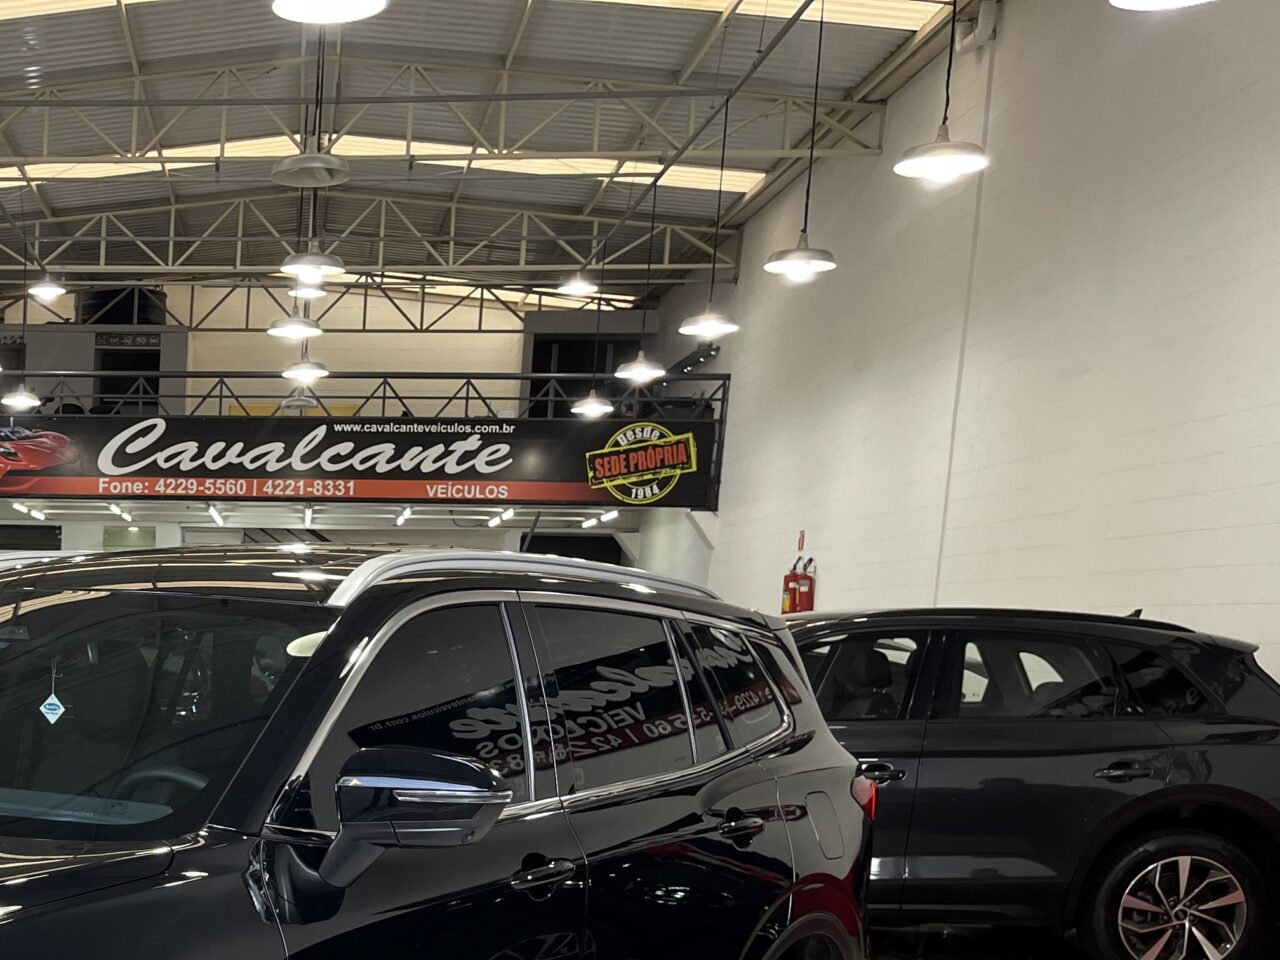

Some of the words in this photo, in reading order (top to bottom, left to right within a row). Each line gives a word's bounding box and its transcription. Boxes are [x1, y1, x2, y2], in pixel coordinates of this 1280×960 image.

[333, 422, 516, 434] www.cavalcanteveiculos.com.br
[97, 417, 513, 476] Cavalcante
[594, 454, 628, 478] SEDE
[628, 443, 688, 472] PRÓPRIA
[98, 477, 150, 494] Fone:
[155, 478, 247, 495] 4229-5560
[262, 480, 356, 496] 4221-8331
[426, 481, 509, 499] VEÍCULOS
[631, 484, 660, 499] 1984
